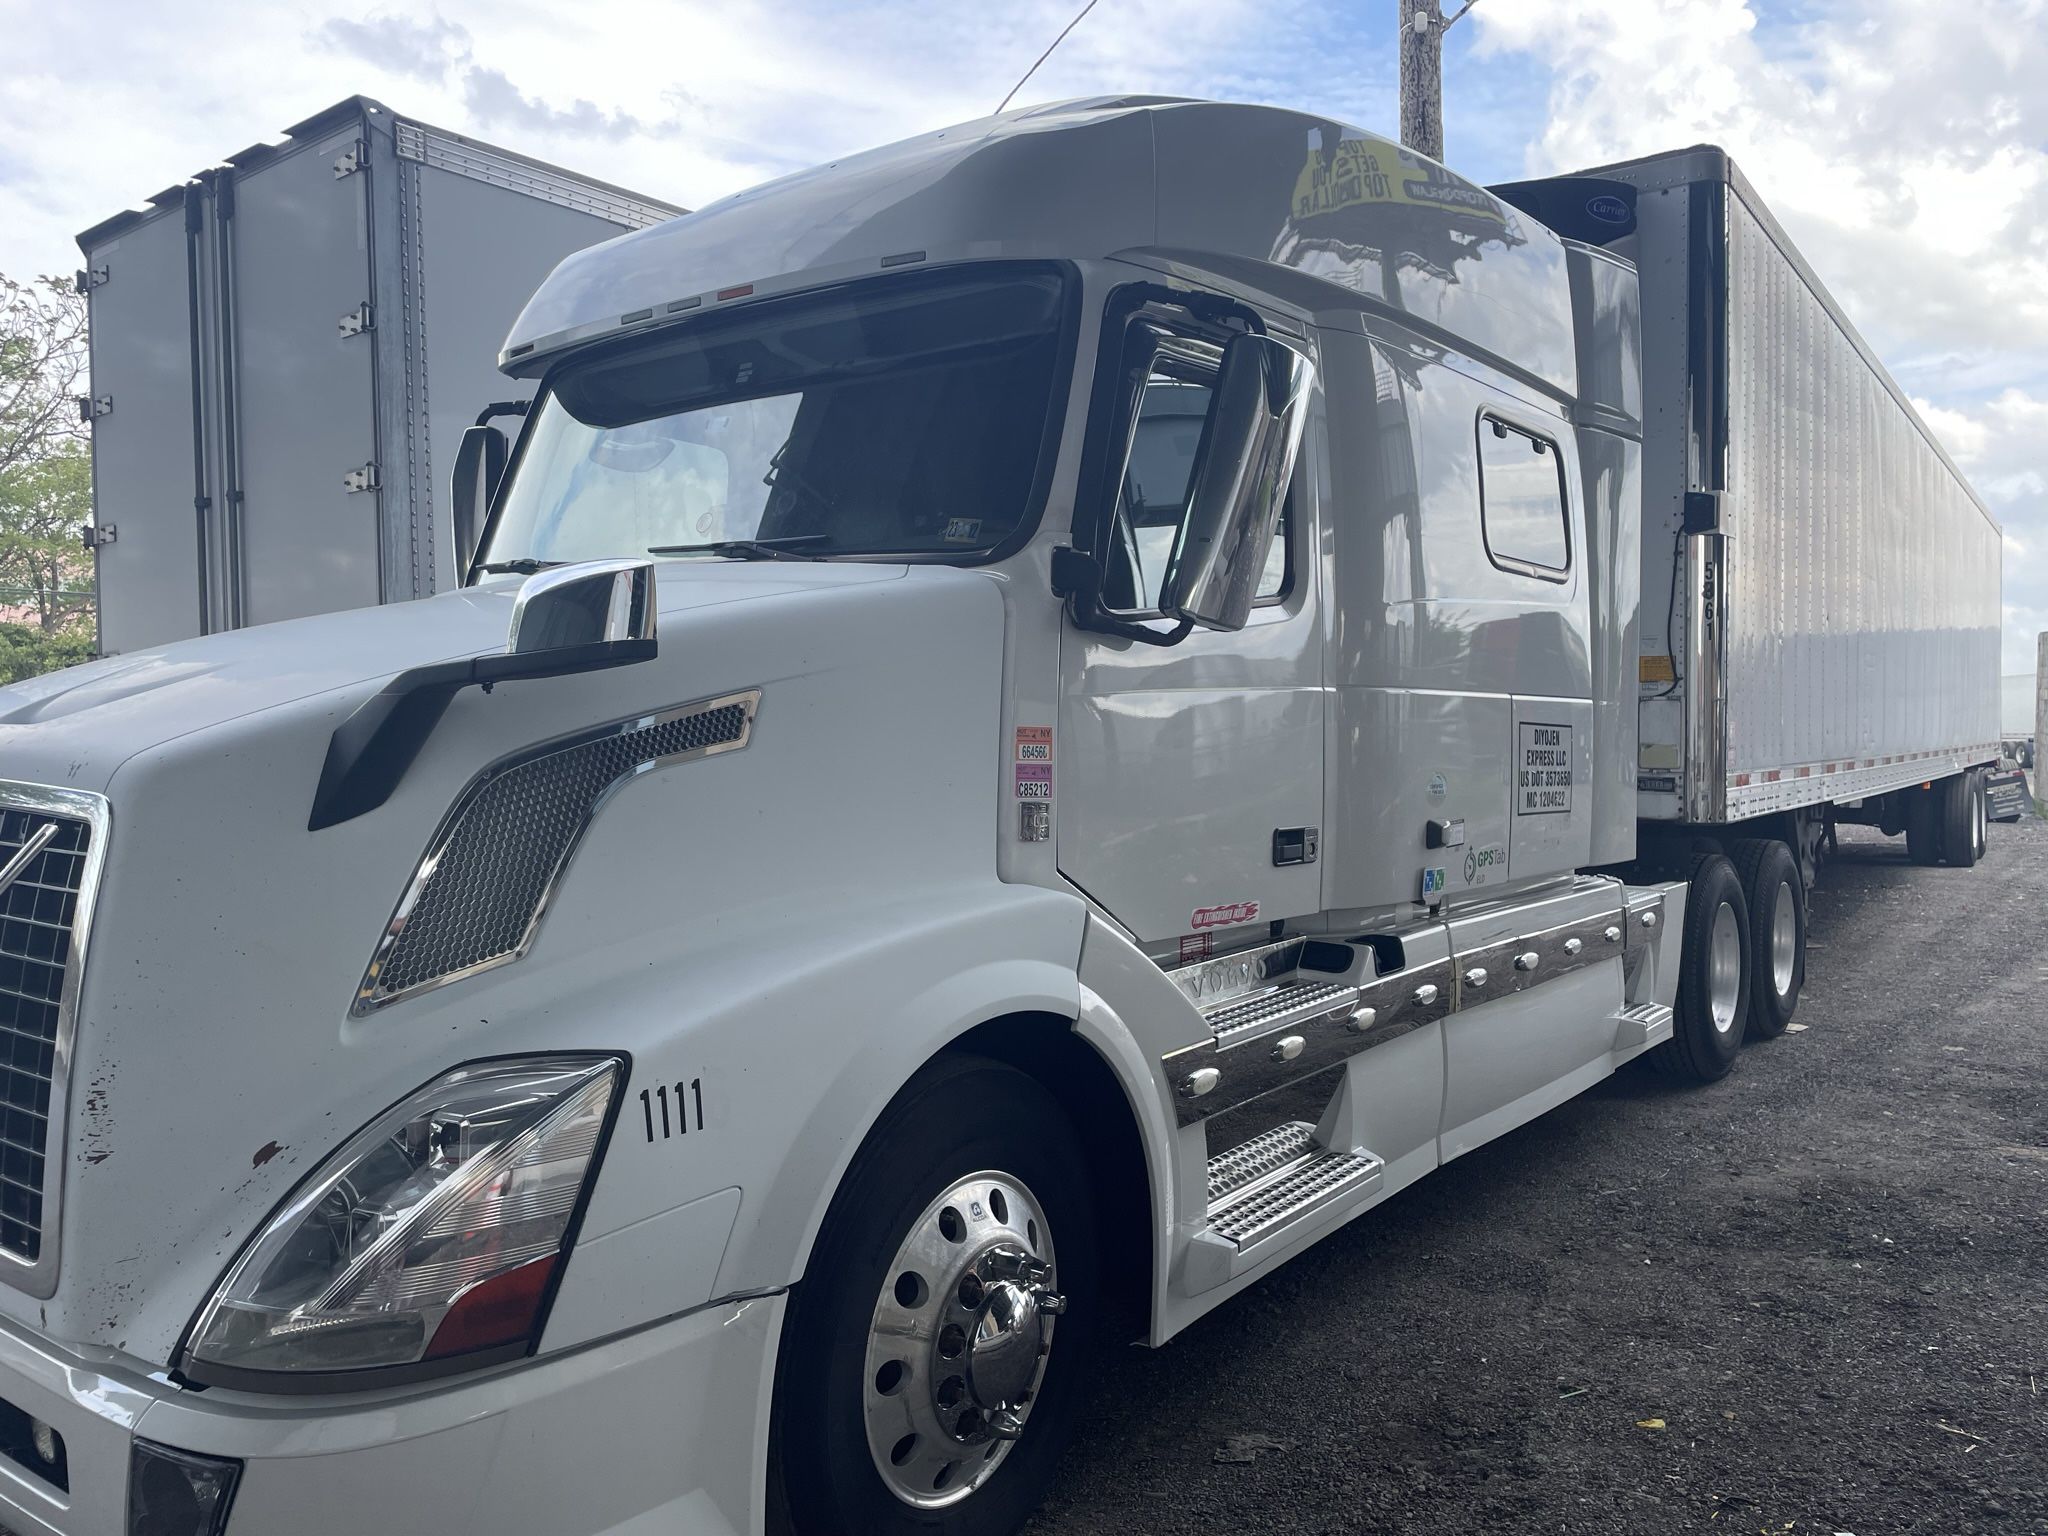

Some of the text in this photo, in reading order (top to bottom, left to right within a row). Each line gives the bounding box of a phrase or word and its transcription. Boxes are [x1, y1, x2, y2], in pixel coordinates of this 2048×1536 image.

[1593, 201, 1625, 216] Carrier
[1040, 729, 1051, 738] NY
[1534, 729, 1560, 746] DIYOJEN
[1527, 750, 1566, 766] EXPRESS LLC
[1521, 771, 1529, 787] US
[1531, 771, 1544, 787] DOT
[1019, 782, 1049, 796] C85212
[1527, 791, 1538, 808] MC
[1184, 957, 1267, 998] VOLVO
[639, 1078, 704, 1143] 1111
